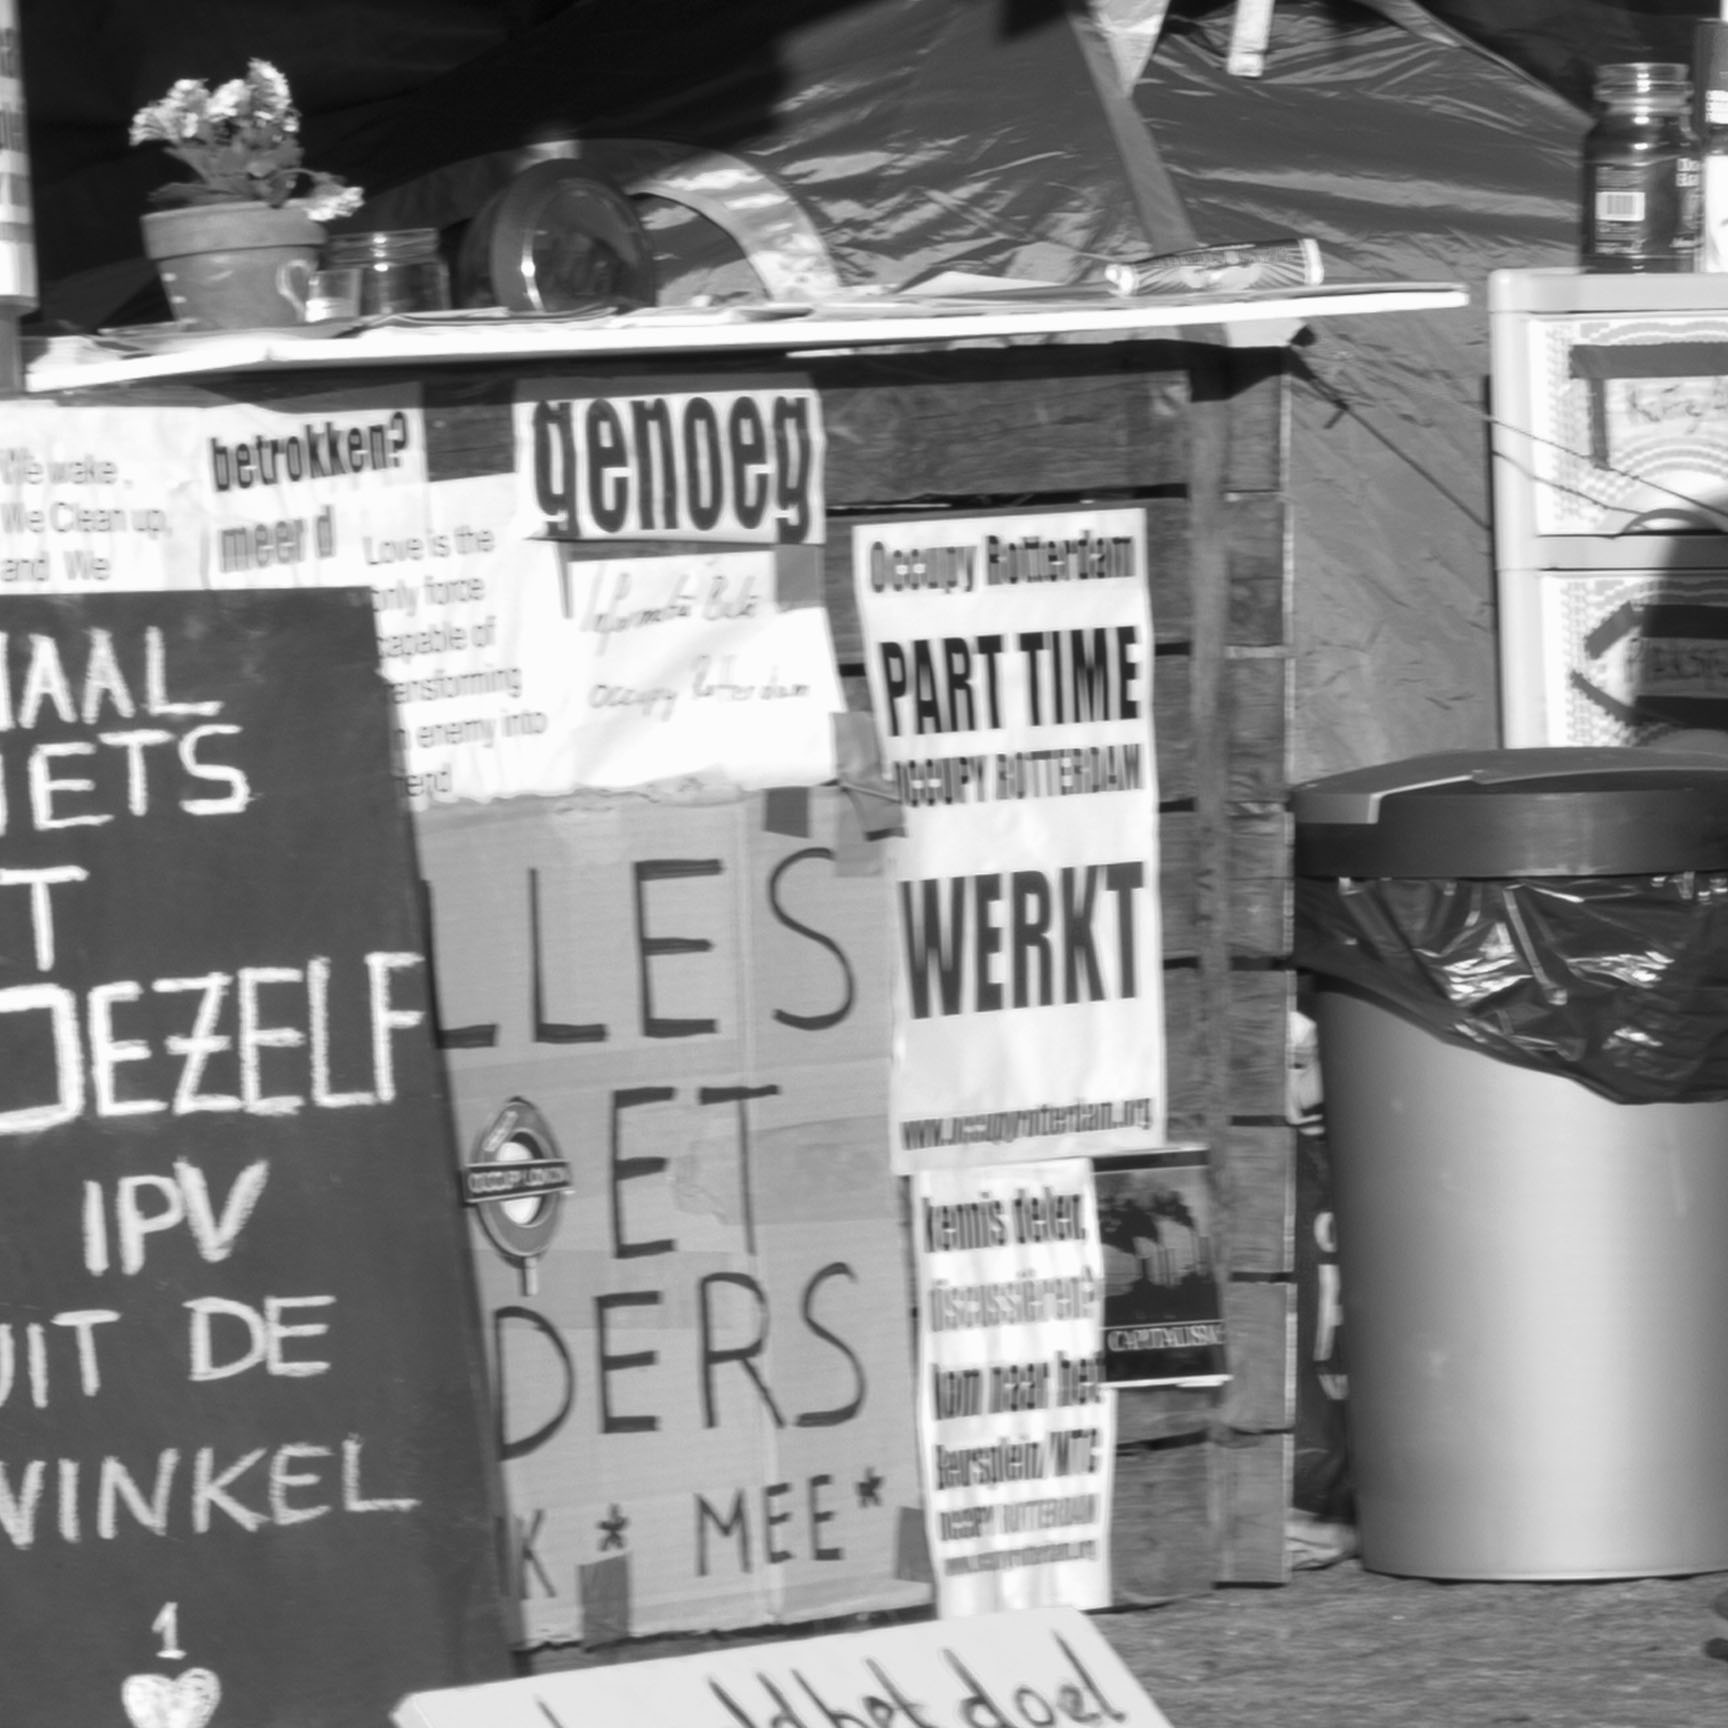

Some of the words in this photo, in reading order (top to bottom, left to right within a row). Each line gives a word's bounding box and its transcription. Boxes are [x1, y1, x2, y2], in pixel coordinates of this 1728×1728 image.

[208, 411, 410, 493] betrokken?
[532, 395, 810, 546] genoeg
[0, 501, 45, 535] We
[361, 534, 425, 568] Love
[453, 524, 496, 557] the
[395, 667, 523, 705] ansforming
[879, 633, 1006, 737] PART
[1017, 625, 1141, 727] TIME
[416, 718, 495, 750] enemy
[899, 860, 1146, 1020] WERKT
[83, 1158, 271, 1275] IPV
[185, 1293, 337, 1381] DE
